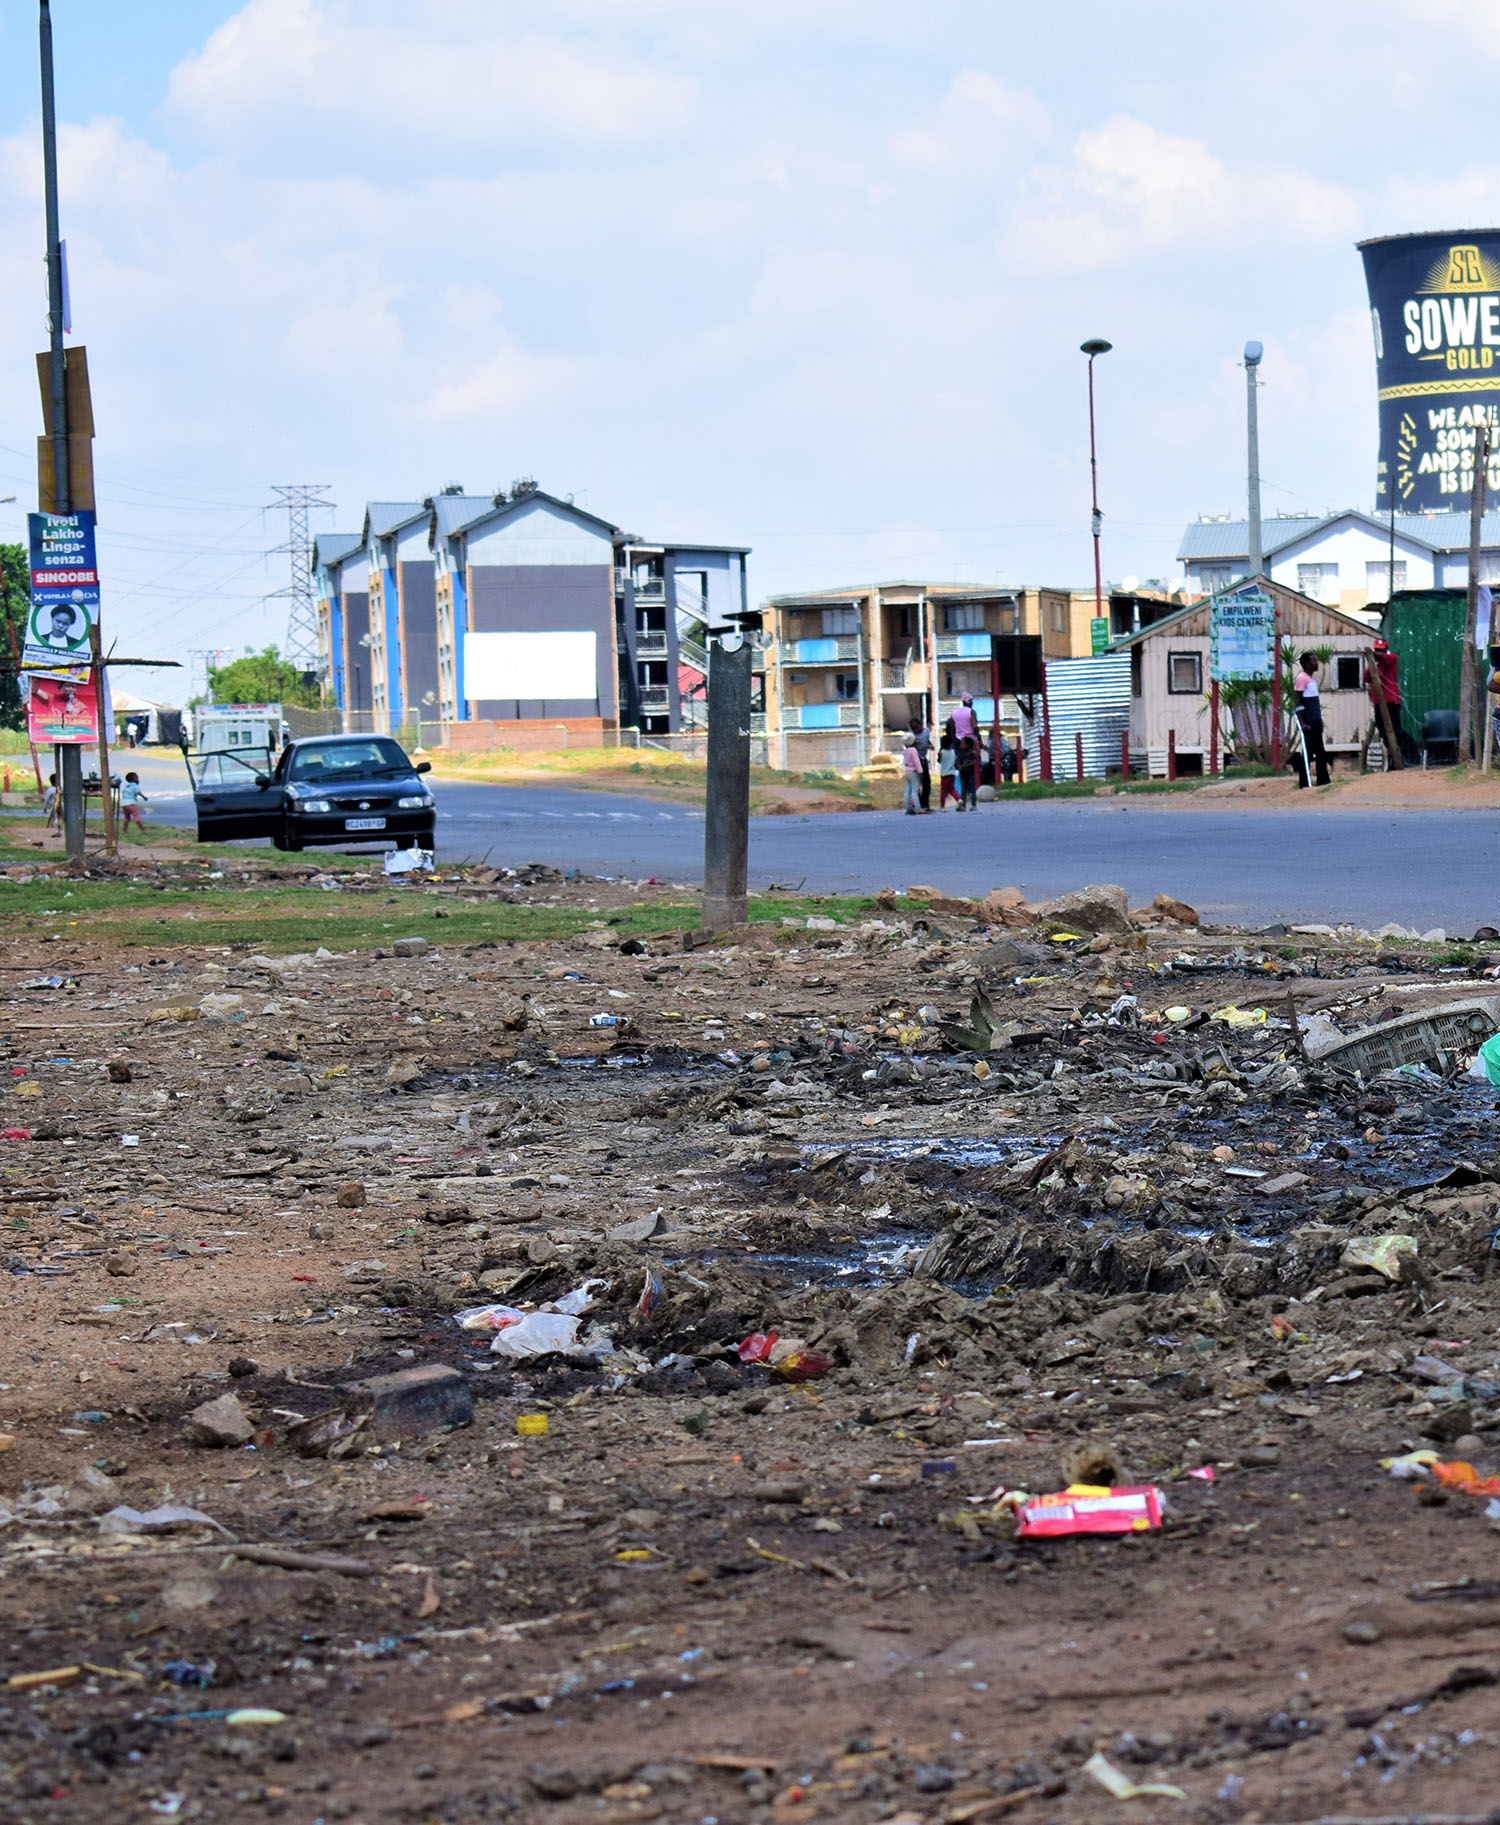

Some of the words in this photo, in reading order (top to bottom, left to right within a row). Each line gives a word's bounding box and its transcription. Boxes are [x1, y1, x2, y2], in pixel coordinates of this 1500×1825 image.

[1450, 250, 1482, 283] SG
[1446, 348, 1493, 371] GOLD
[1428, 407, 1457, 430] WE
[1457, 404, 1499, 428] ARE
[1418, 450, 1460, 474] AND
[1440, 471, 1458, 494] IS
[47, 516, 79, 527] Ivoti
[42, 528, 85, 540] Lakho
[42, 541, 86, 553] Linga-
[45, 555, 85, 565] senza
[1223, 606, 1262, 616] EMPILWENI
[1219, 617, 1236, 627] KIDS
